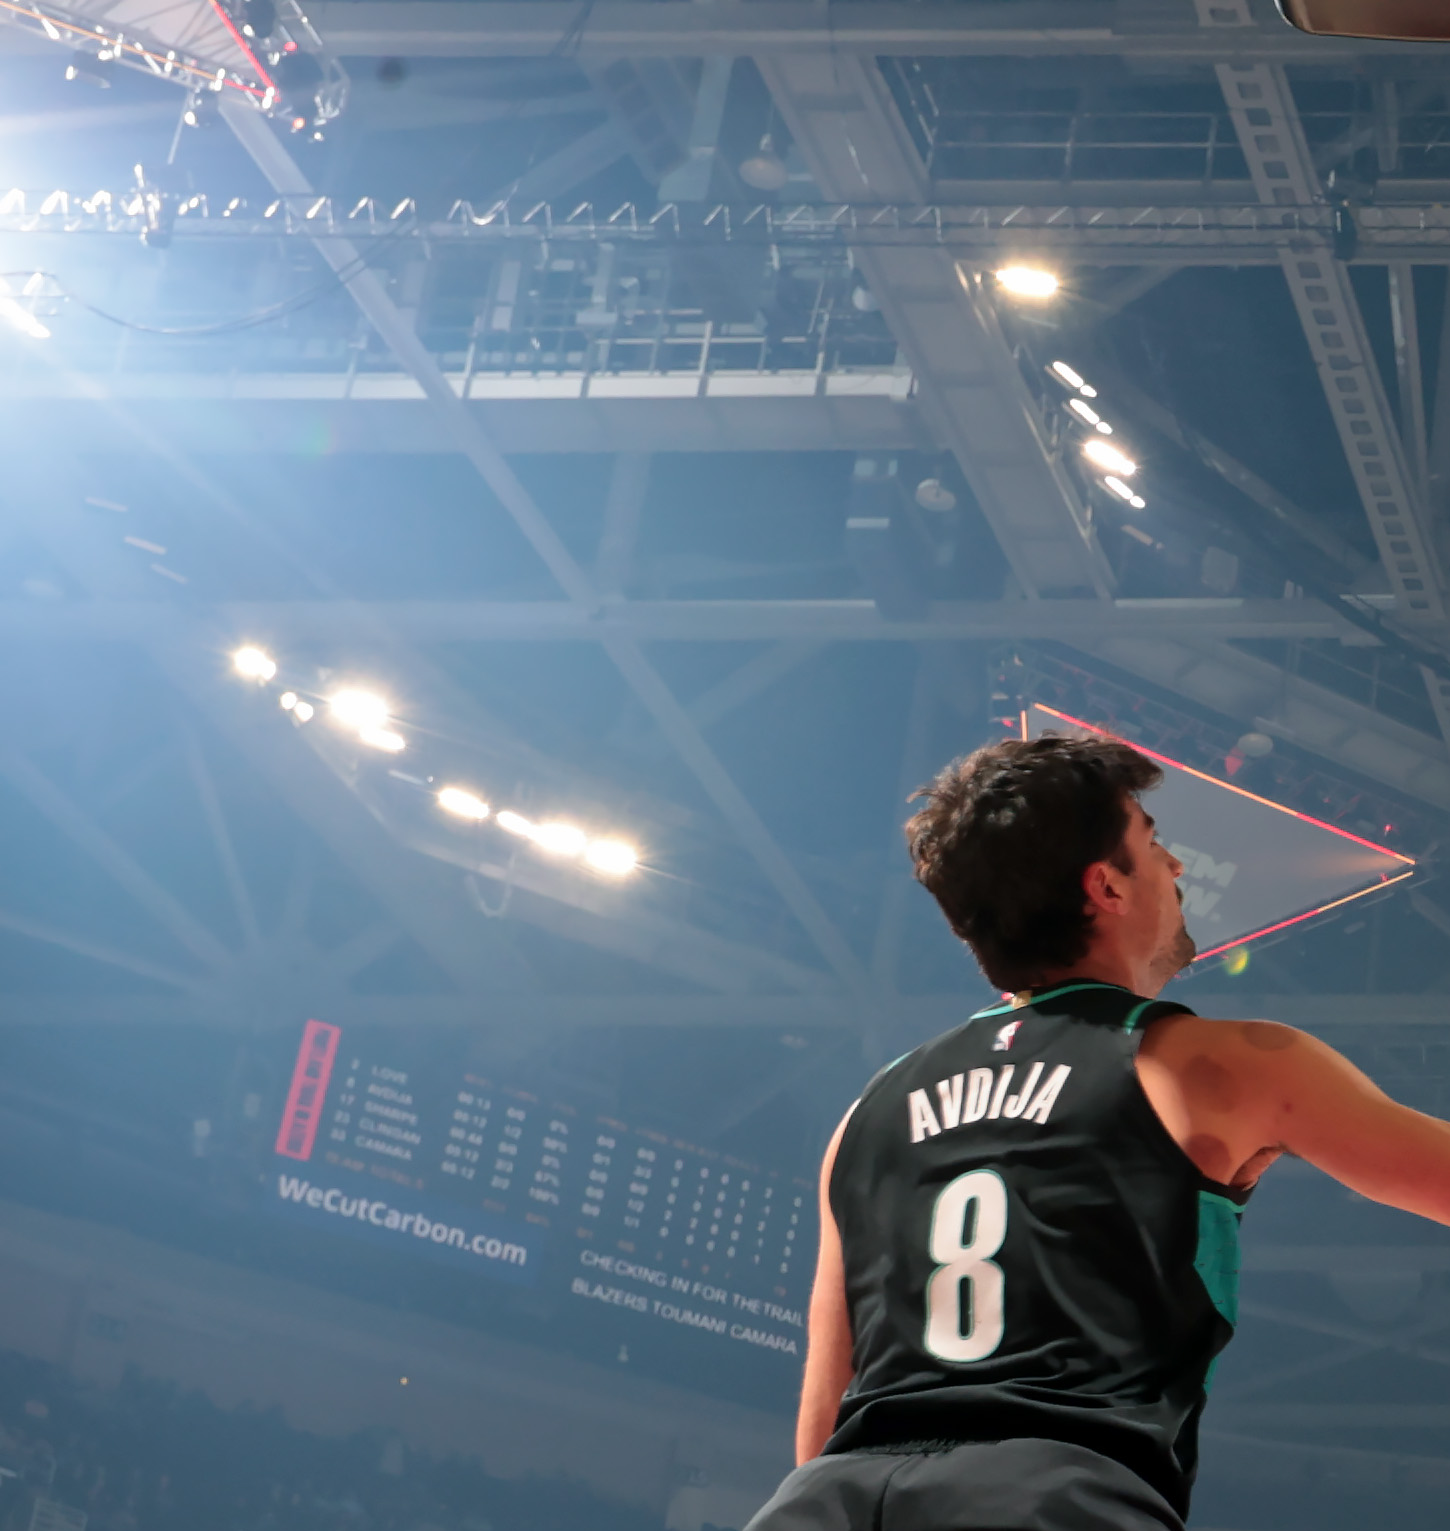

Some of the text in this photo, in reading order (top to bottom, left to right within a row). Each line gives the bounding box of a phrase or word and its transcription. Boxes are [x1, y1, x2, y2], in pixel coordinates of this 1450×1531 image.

[906, 1060, 1072, 1144] AVDIJA
[278, 1174, 527, 1267] WeCutCarbon.com
[571, 1276, 648, 1313] BLAZERS
[580, 1249, 667, 1288] CHECKING
[922, 1168, 1008, 1364] 8
